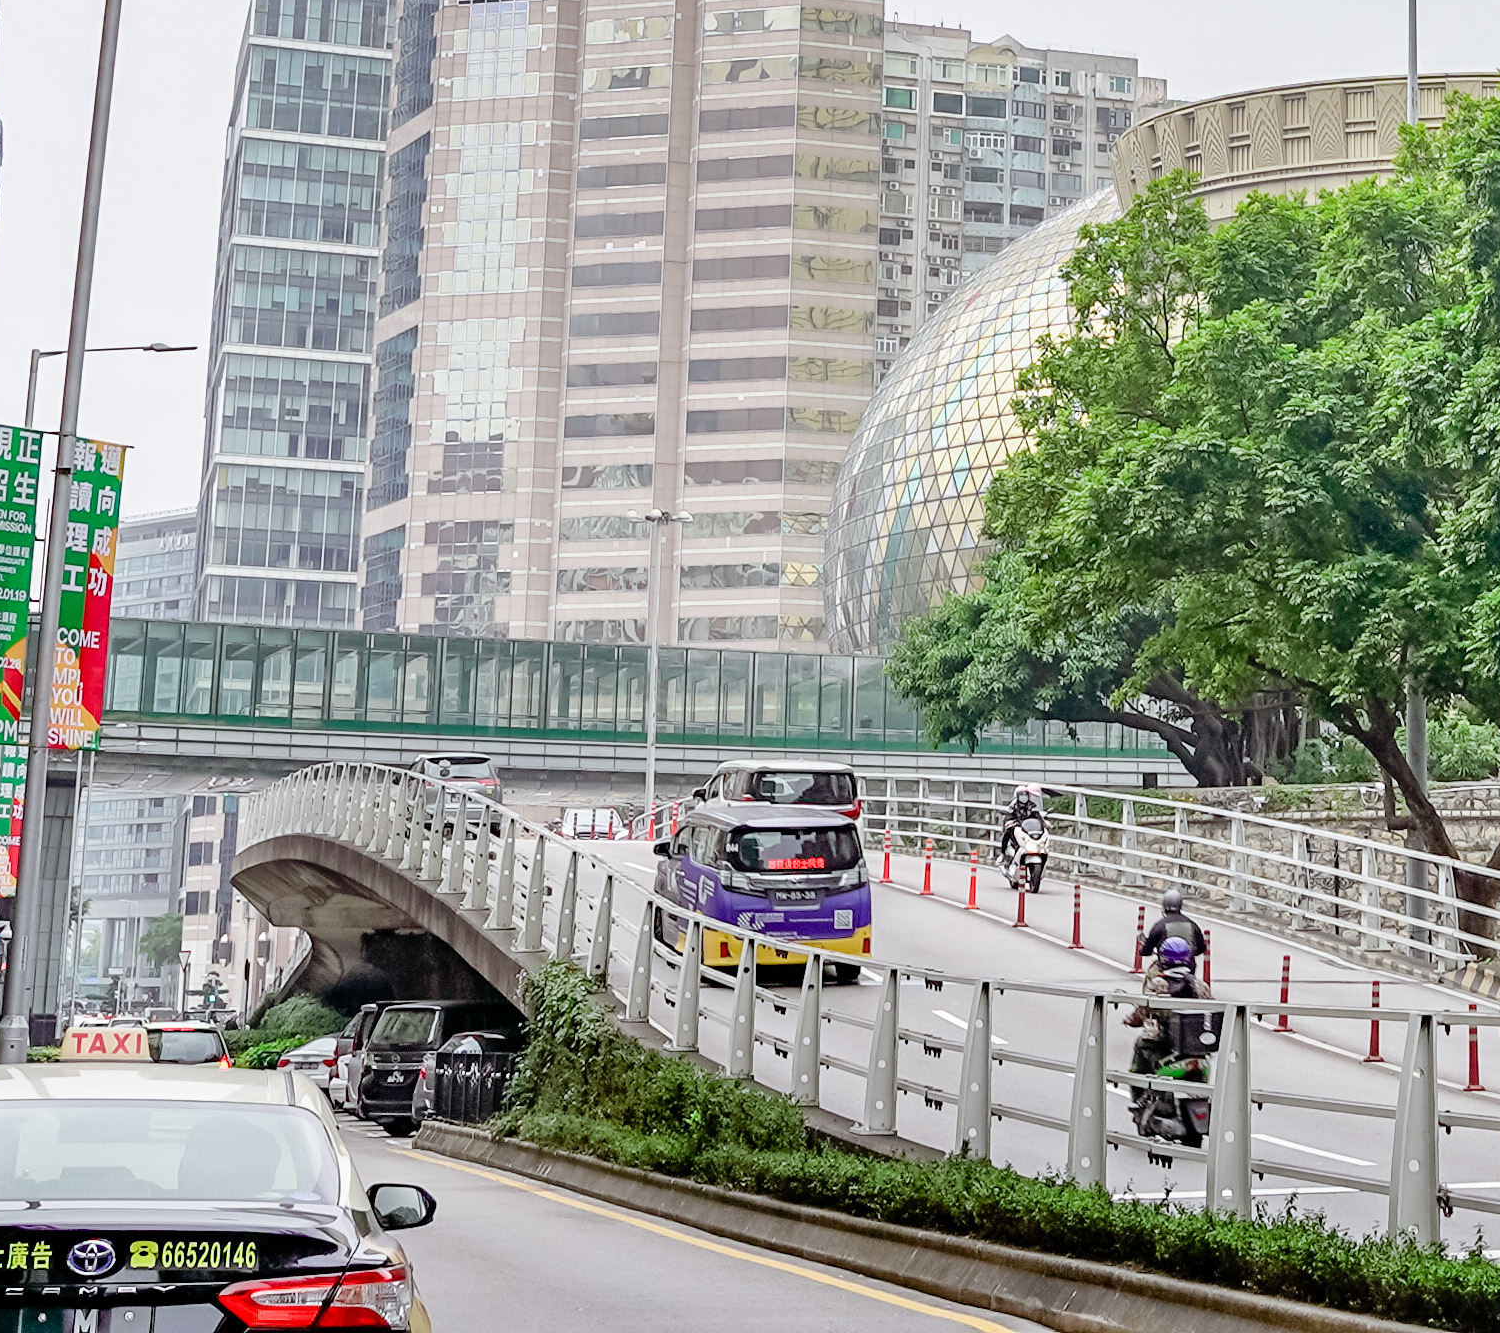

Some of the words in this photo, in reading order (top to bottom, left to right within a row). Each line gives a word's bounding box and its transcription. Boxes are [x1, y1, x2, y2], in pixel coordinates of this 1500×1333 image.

[8, 509, 27, 523] FOR
[56, 626, 101, 649] COME
[55, 646, 76, 665] TO
[52, 666, 83, 689] MPI,
[51, 686, 83, 706] YOU
[49, 706, 85, 727] WILL
[47, 727, 97, 749] SHINE!
[71, 1033, 142, 1054] TAXI
[161, 1241, 258, 1271] 66520146
[5, 1284, 177, 1296] CAMRY
